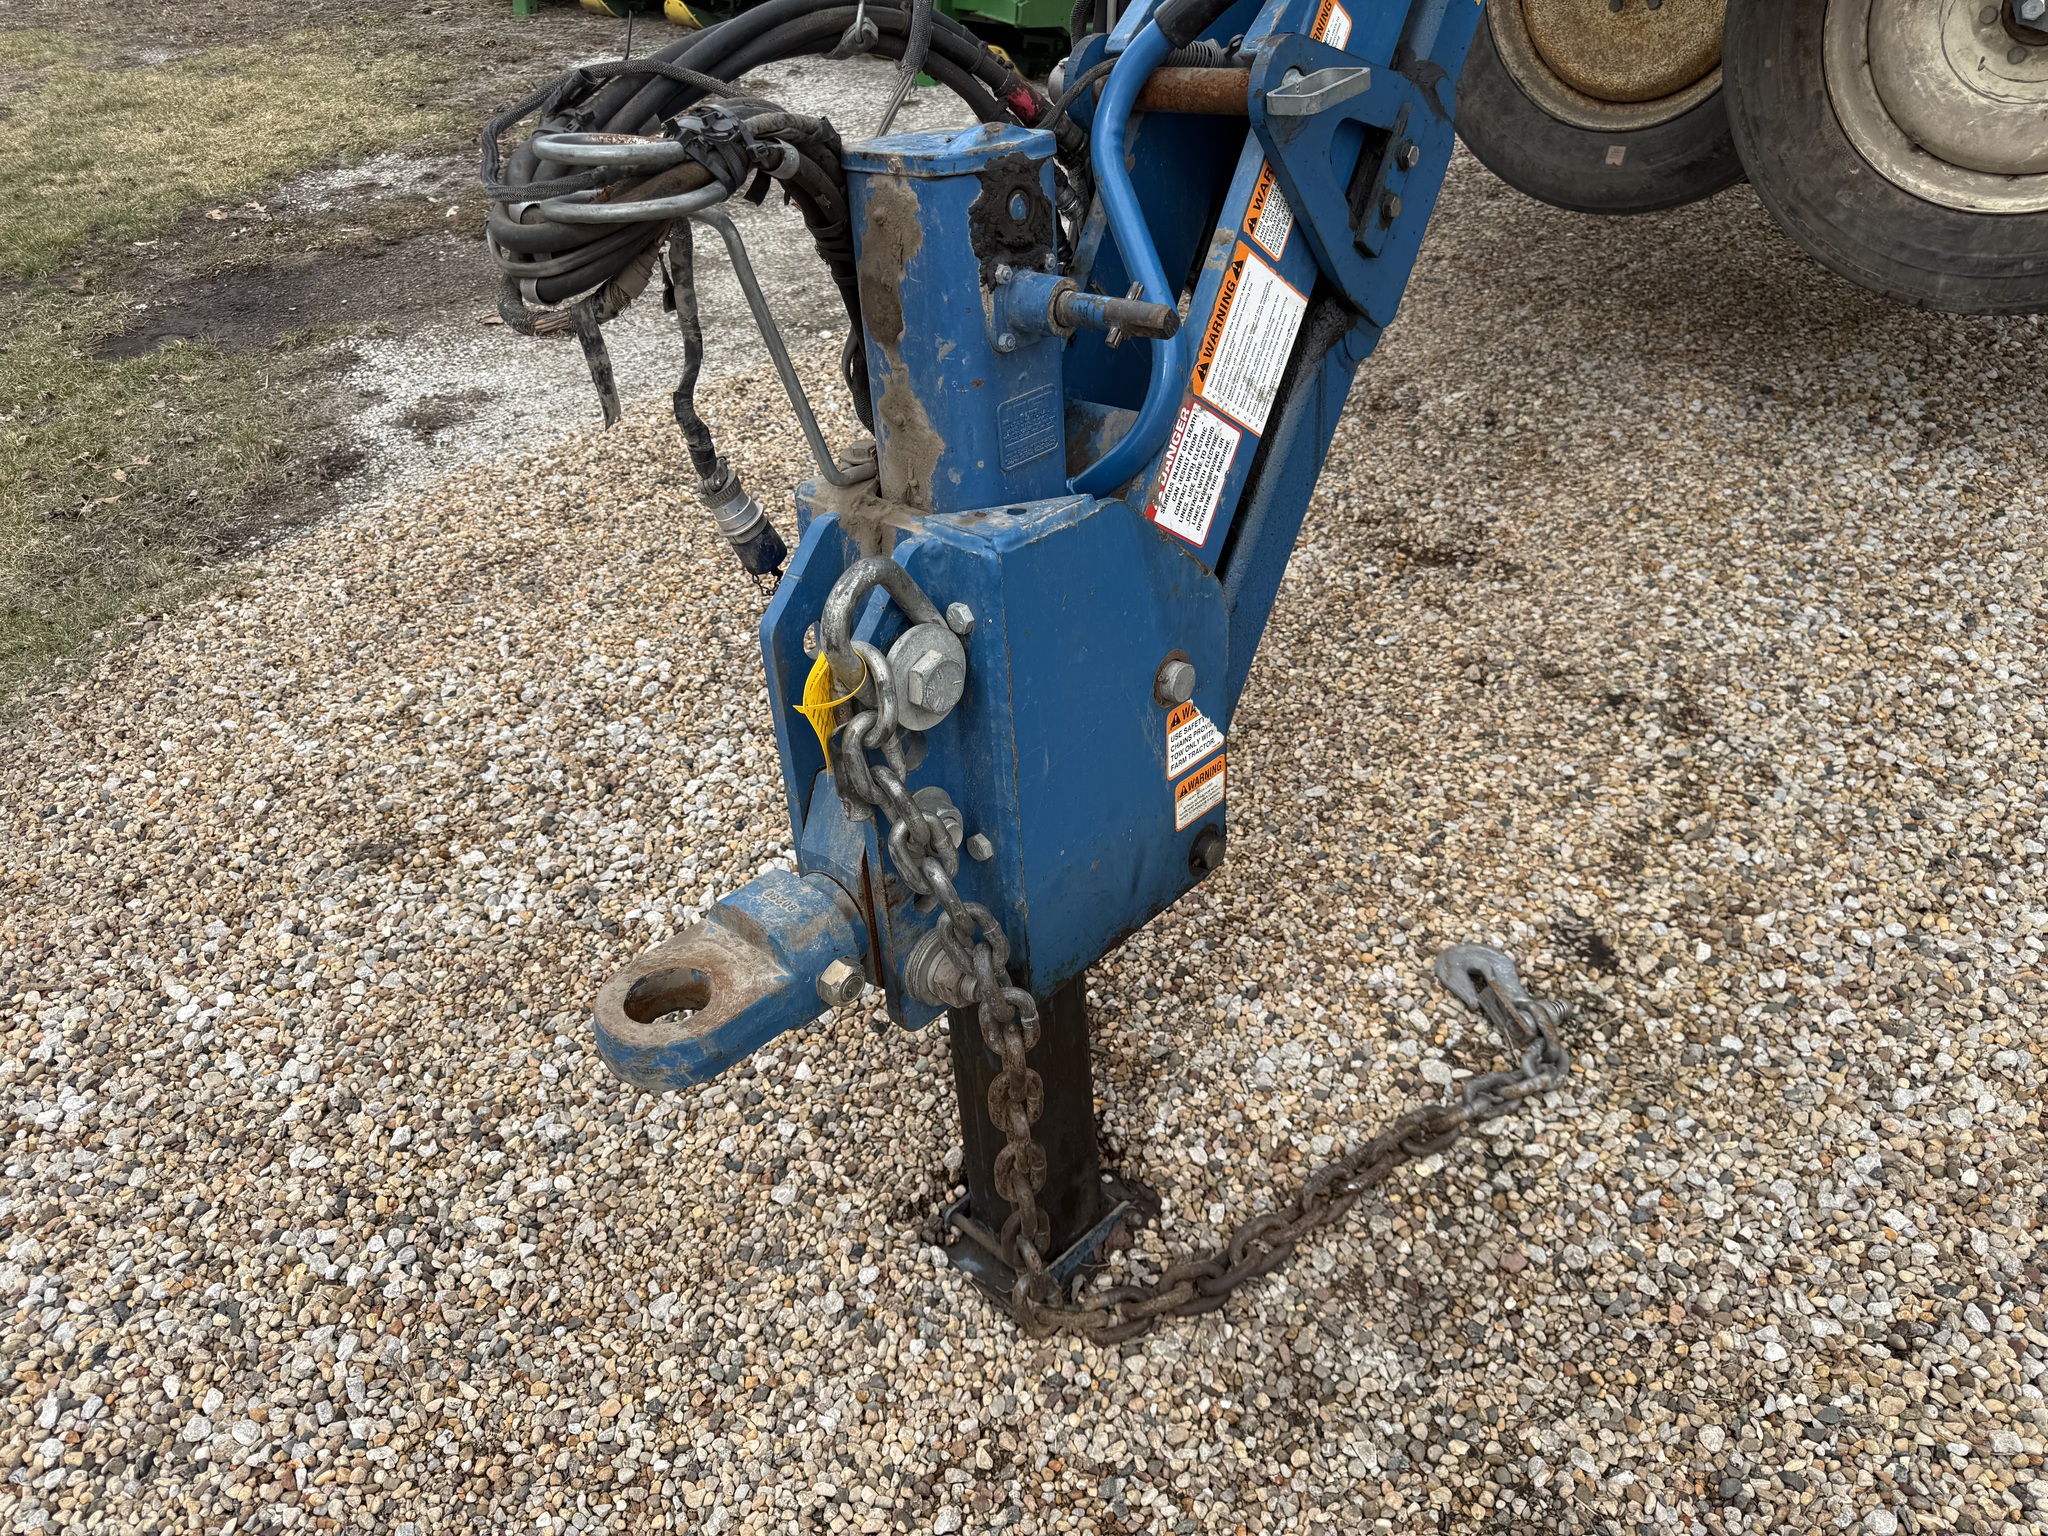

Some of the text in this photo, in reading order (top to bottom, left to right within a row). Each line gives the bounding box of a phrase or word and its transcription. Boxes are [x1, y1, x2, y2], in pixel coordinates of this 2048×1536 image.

[1313, 0, 1332, 40] RNING
[1253, 167, 1273, 210] WAR
[1204, 281, 1235, 357] WARNING
[1172, 453, 1184, 480] INJURY
[1182, 440, 1189, 451] OR
[1186, 414, 1198, 438] DEATH
[1172, 487, 1180, 502] CAN
[1188, 434, 1198, 455] FROM
[1174, 427, 1207, 515] CONTACT WITH ELECTRIC
[1187, 483, 1195, 497] USE
[1193, 462, 1202, 481] CARE
[1200, 450, 1206, 459] TO
[1205, 426, 1214, 448] AVOID
[1186, 434, 1218, 521] CONTACT WITH ELECTRIC
[1192, 505, 1201, 525] LINES
[1218, 438, 1224, 448] OR
[1196, 440, 1230, 531] OPERATING THIS MACHINE.
[1171, 730, 1182, 742] USE
[1182, 705, 1196, 719] WA
[1171, 734, 1192, 752] CHAINS
[1171, 749, 1184, 761] TOW
[1185, 738, 1200, 752] ONLY
[1171, 756, 1186, 771] FARM
[1188, 761, 1221, 790] WARNING
